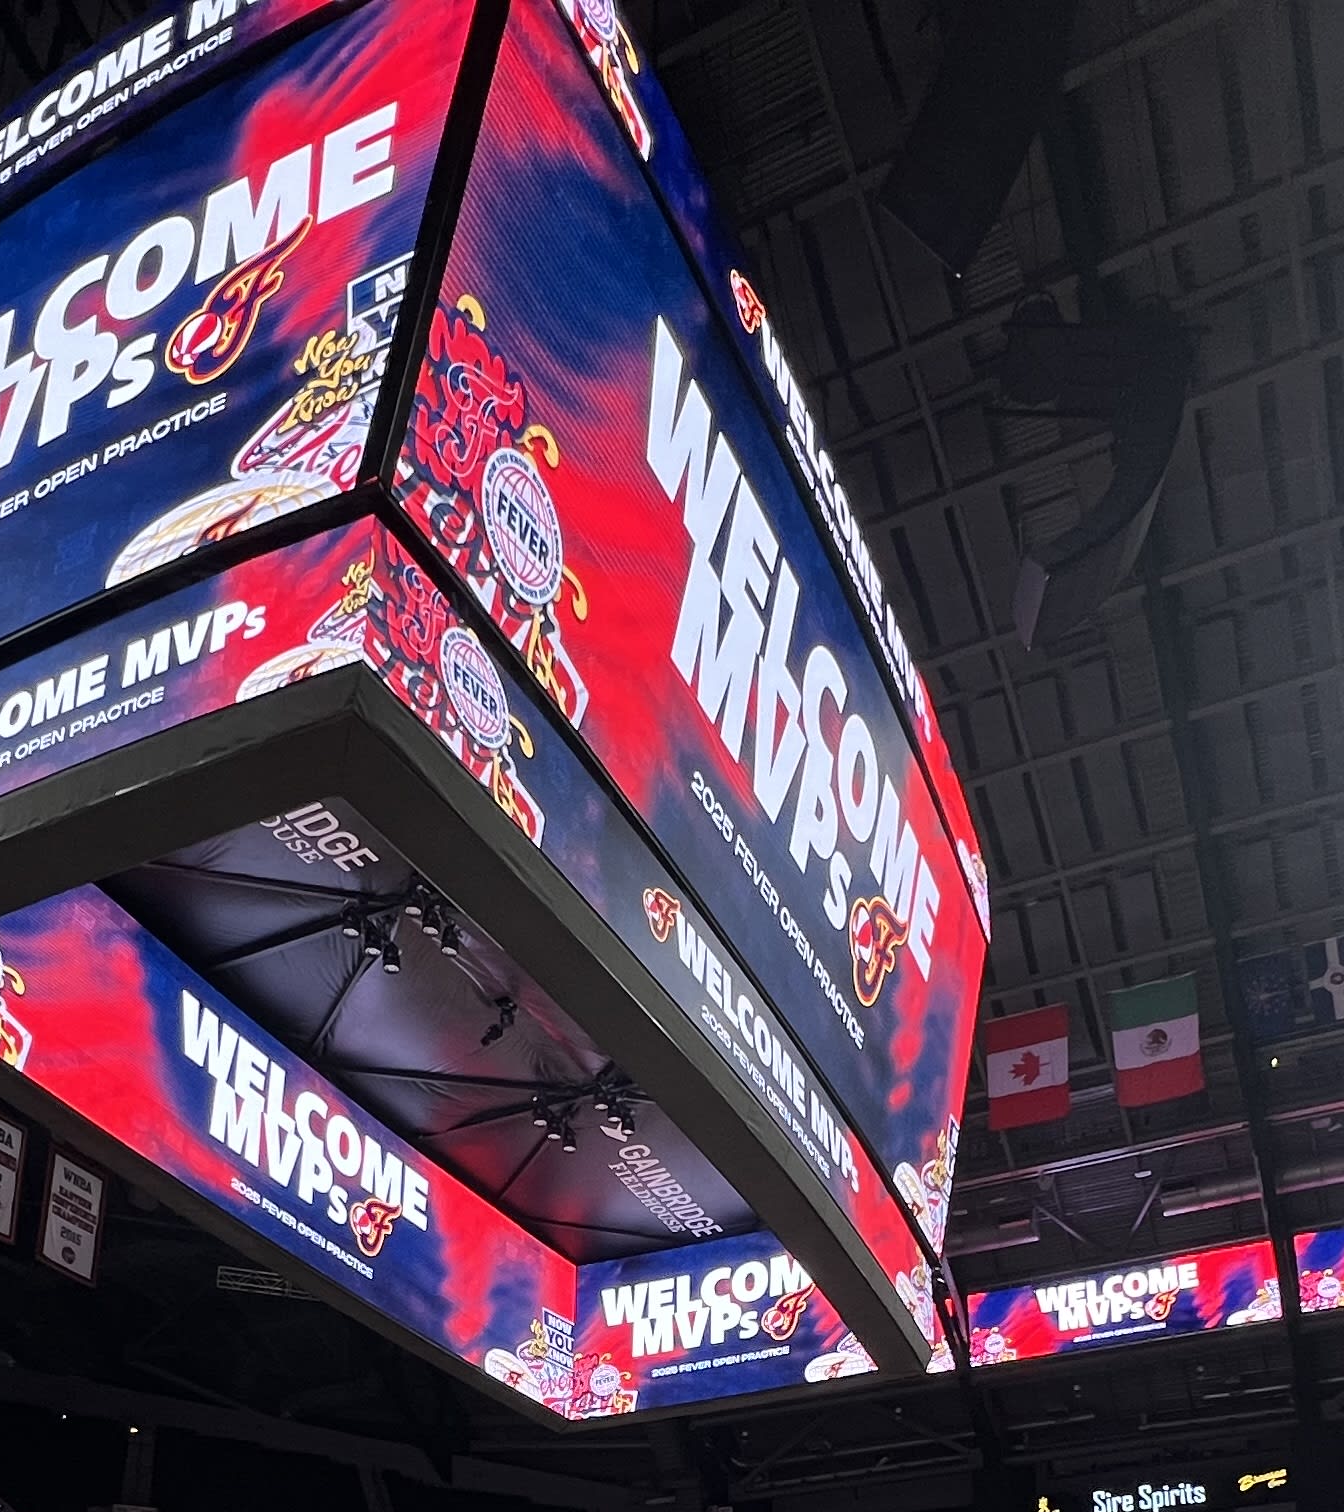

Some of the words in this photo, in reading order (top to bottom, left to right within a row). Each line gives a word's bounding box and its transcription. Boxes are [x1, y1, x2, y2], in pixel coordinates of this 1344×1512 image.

[14, 124, 73, 175] FEVER
[75, 87, 130, 131] OPEN
[133, 26, 233, 96] PRACTICE
[32, 455, 98, 502] OPEN
[102, 392, 228, 460] PRACTICE
[496, 489, 550, 570] FEVER
[121, 600, 267, 689] MVPs
[648, 315, 940, 982] WELCOME
[15, 727, 66, 761] OPEN
[69, 686, 165, 738] PRACTICE
[453, 668, 500, 720] FEVER
[670, 540, 853, 932] MVPs
[690, 771, 735, 843] 2025
[735, 838, 780, 916] FEVER
[781, 906, 814, 970] OPEN
[814, 957, 866, 1051] PRACTICE
[676, 911, 807, 1119] WELCOME
[811, 1090, 860, 1194] MVPs
[701, 1005, 732, 1050] 2025
[733, 1042, 766, 1094] FEVER
[766, 1085, 793, 1126] OPEN
[792, 1117, 832, 1180] PRACTICE
[181, 988, 430, 1233] WELCOME
[209, 1080, 348, 1227] MVPs
[63, 1167, 92, 1195] WNBA
[607, 1161, 687, 1234] FIELDHOUSE
[618, 1143, 724, 1239] GAINBRIDGE
[261, 1190, 297, 1231] FEVER
[297, 1215, 327, 1250] OPEN
[326, 1233, 374, 1280] PRACTICE
[600, 1254, 815, 1327] WELCOM
[631, 1299, 760, 1358] MVPs
[1034, 1261, 1200, 1314] WELCOME
[1058, 1297, 1146, 1333] MVPs
